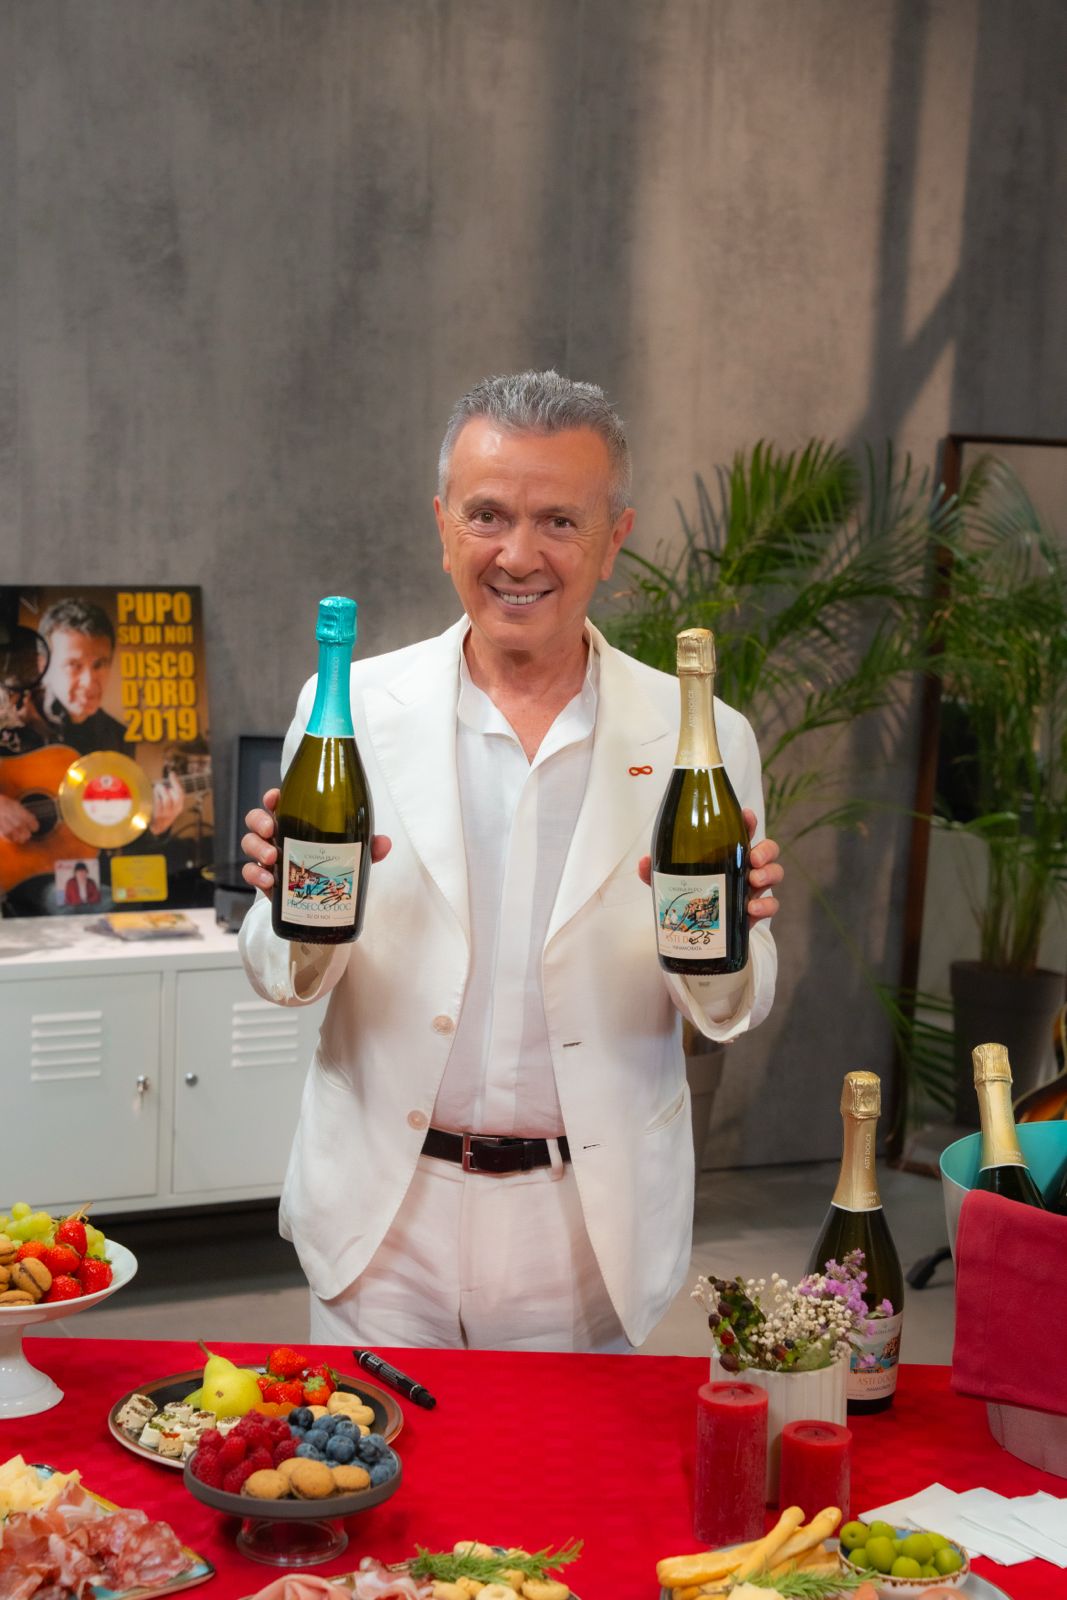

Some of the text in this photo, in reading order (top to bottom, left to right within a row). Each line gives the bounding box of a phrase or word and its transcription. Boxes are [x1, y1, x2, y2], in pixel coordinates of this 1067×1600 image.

[117, 592, 192, 624] PUPO
[118, 625, 193, 644] SU DI NOI
[120, 651, 195, 678] DISCO
[121, 678, 196, 707] D'ORO
[123, 708, 197, 742] 2019
[287, 899, 333, 912] PROSECCO
